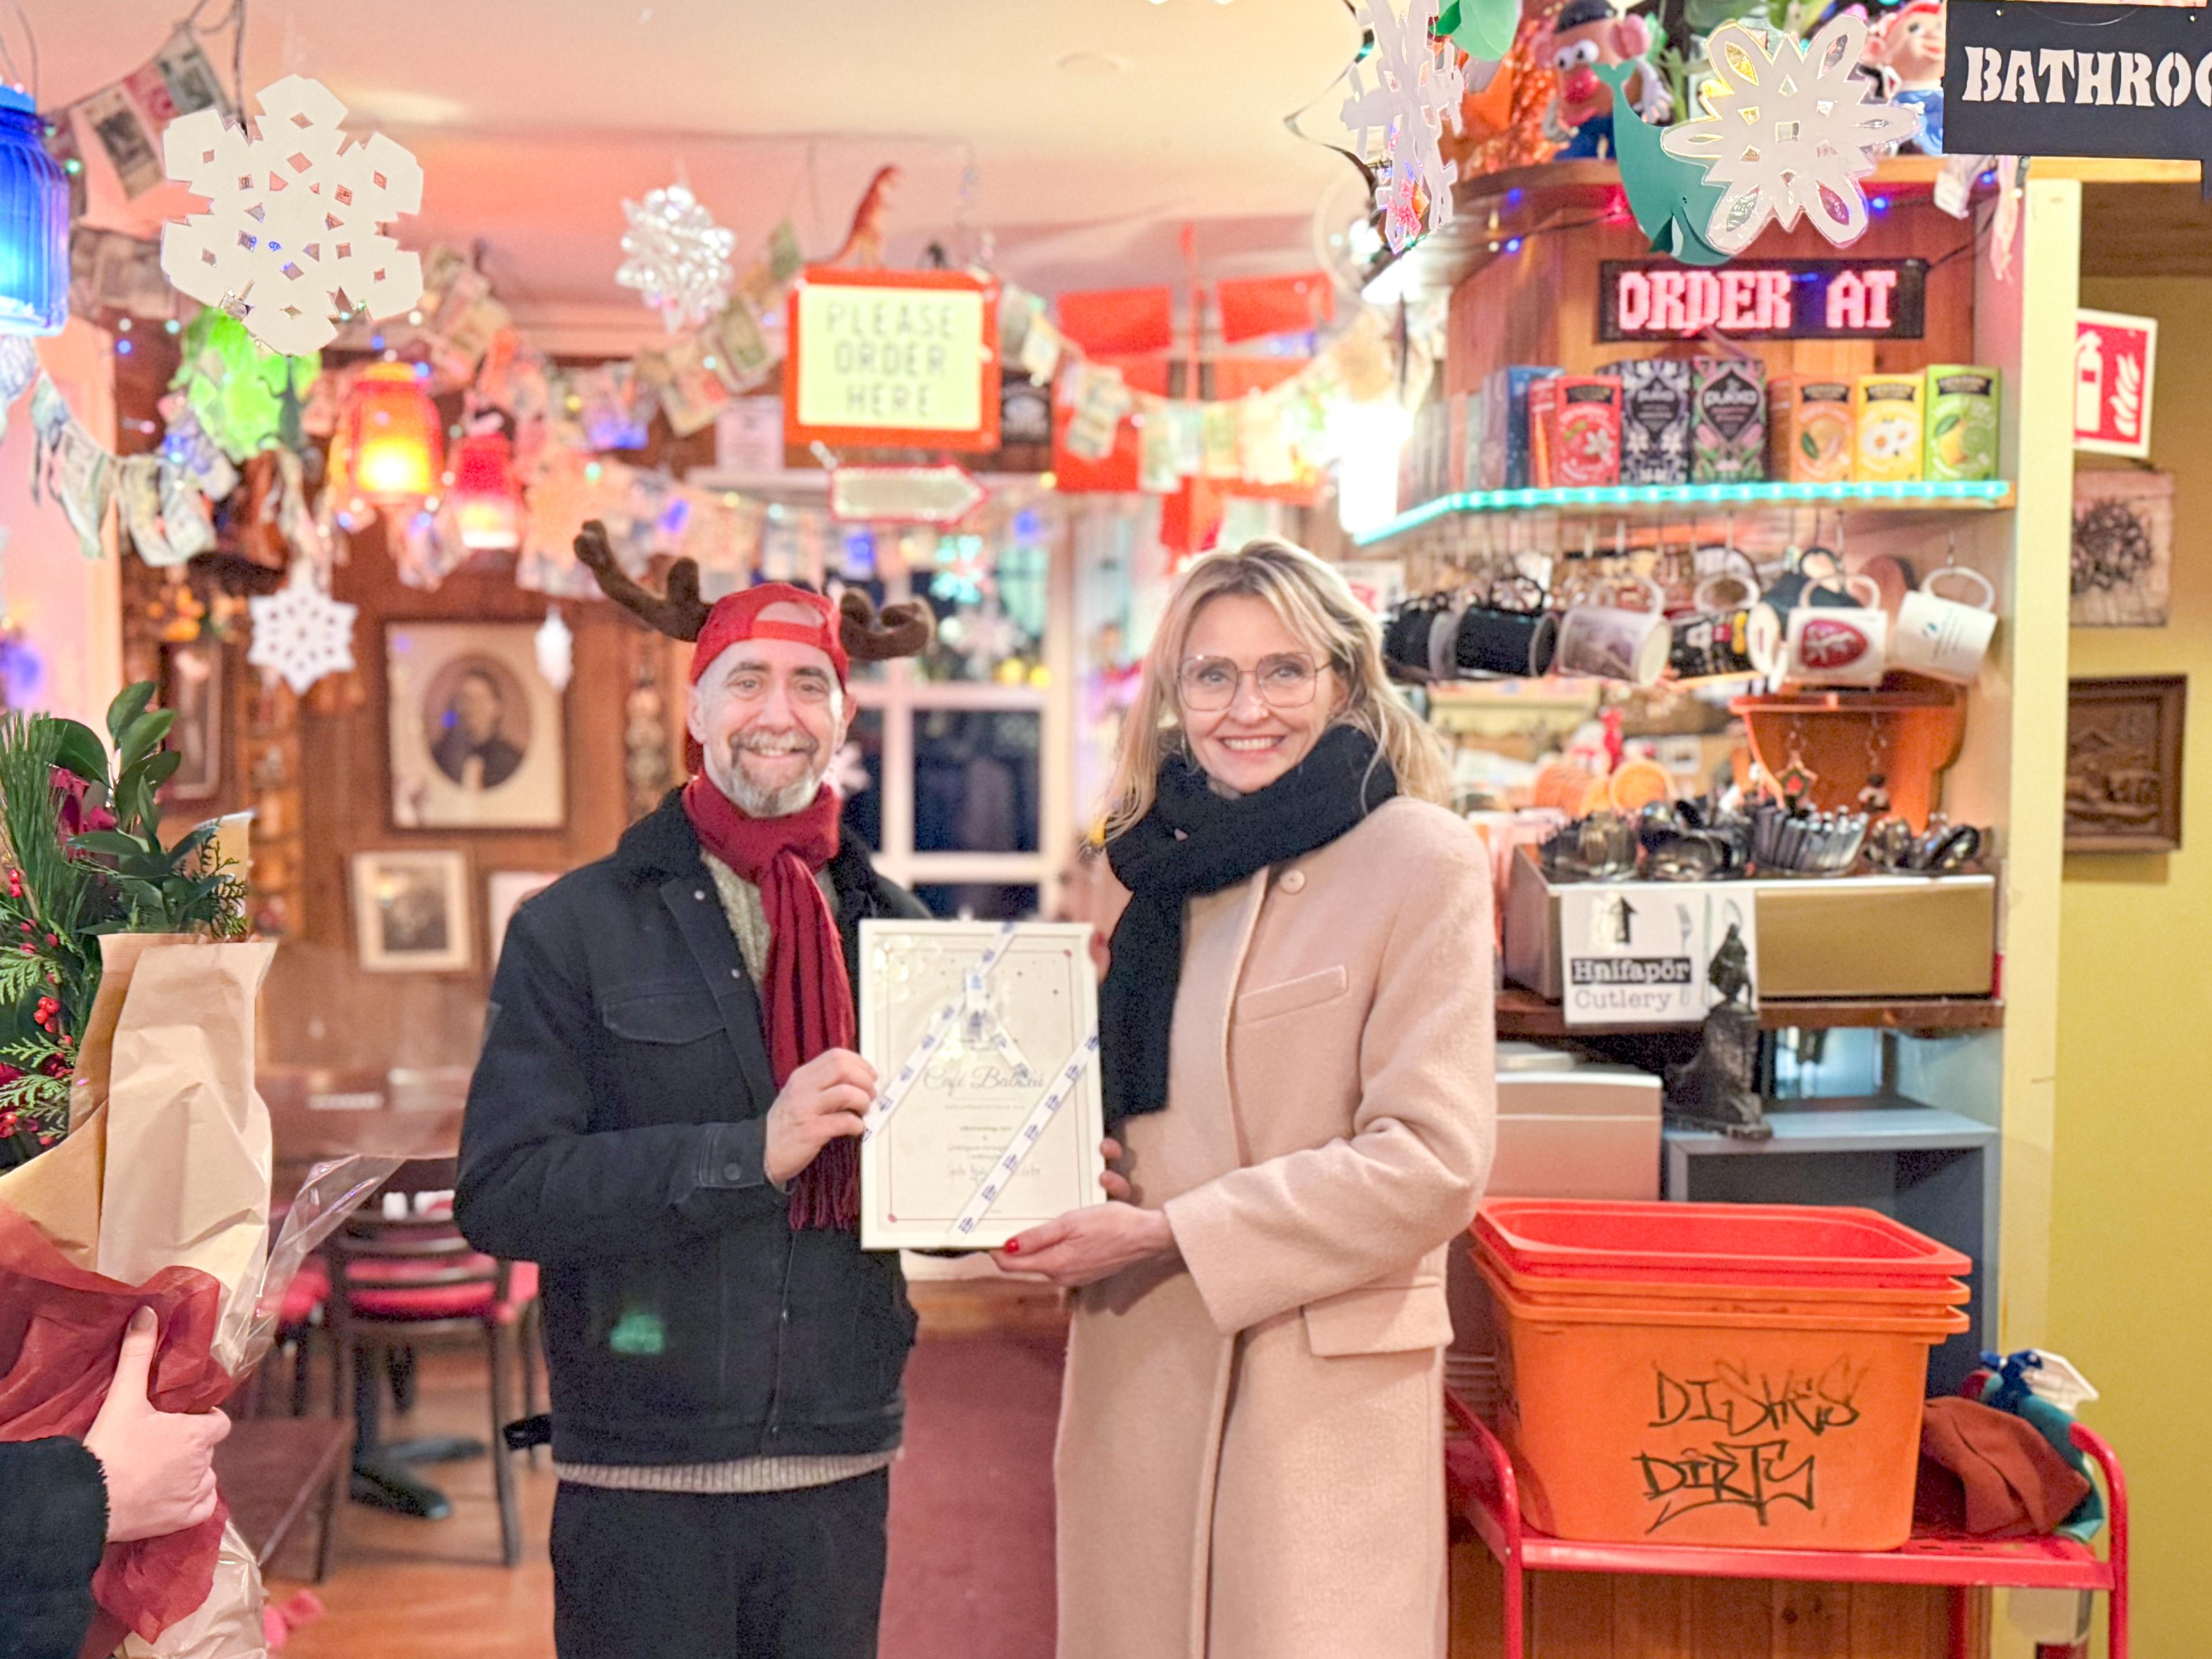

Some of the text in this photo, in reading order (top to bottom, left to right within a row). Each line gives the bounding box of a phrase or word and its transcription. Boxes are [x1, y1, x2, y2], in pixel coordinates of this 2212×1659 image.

[1619, 270, 1897, 330] ORDER AT
[825, 302, 952, 340] PLEASE
[834, 339, 948, 378] ORDER
[845, 382, 929, 417] HERE
[1574, 988, 1672, 1012] Cutlery
